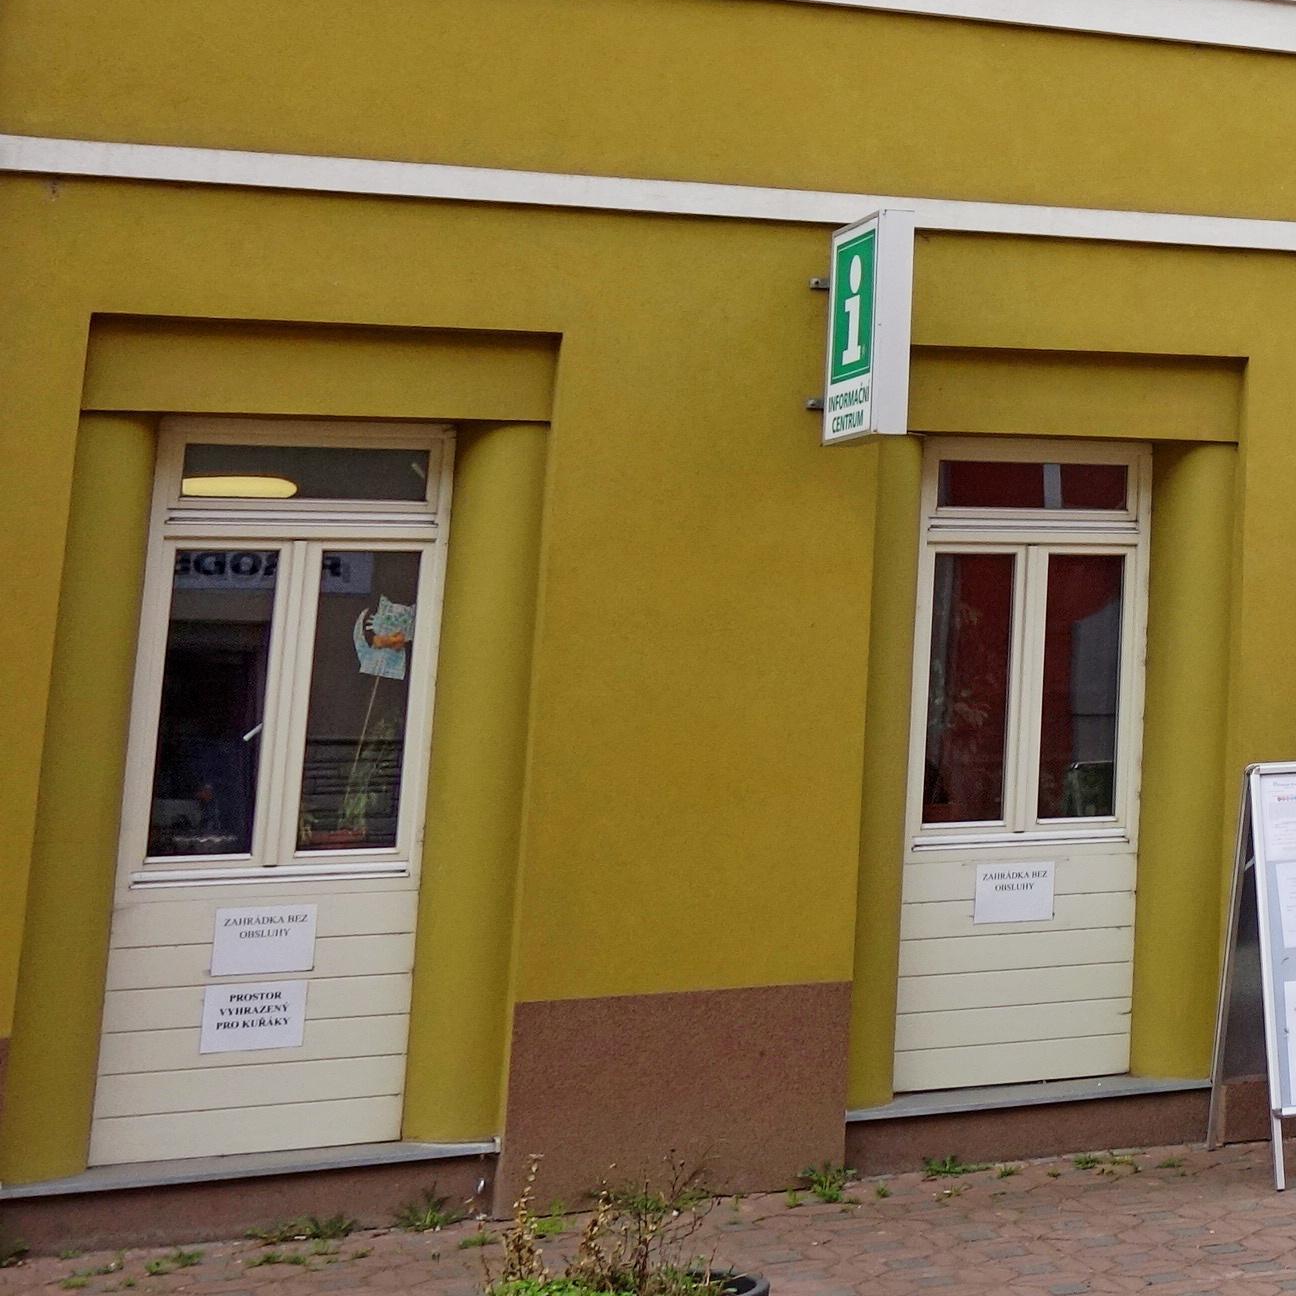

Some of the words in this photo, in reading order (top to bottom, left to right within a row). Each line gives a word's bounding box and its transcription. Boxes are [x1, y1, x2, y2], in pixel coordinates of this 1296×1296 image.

[828, 380, 870, 413] INFORMAČNÍ
[832, 409, 864, 434] CENTRUM
[982, 870, 1030, 881] ZAHRÁDKA
[1031, 870, 1048, 879] BEZ
[994, 883, 1034, 892] OBSLUHY
[223, 914, 285, 927] ZAHRÁDKA
[287, 913, 309, 923] BEZ
[239, 927, 291, 940] OBSLUHY
[229, 991, 282, 1003] PROSTOR
[218, 1002, 290, 1017] VYHRAZENÝ
[215, 1020, 240, 1031] PRO
[241, 1016, 291, 1030] KUŘÁKY
